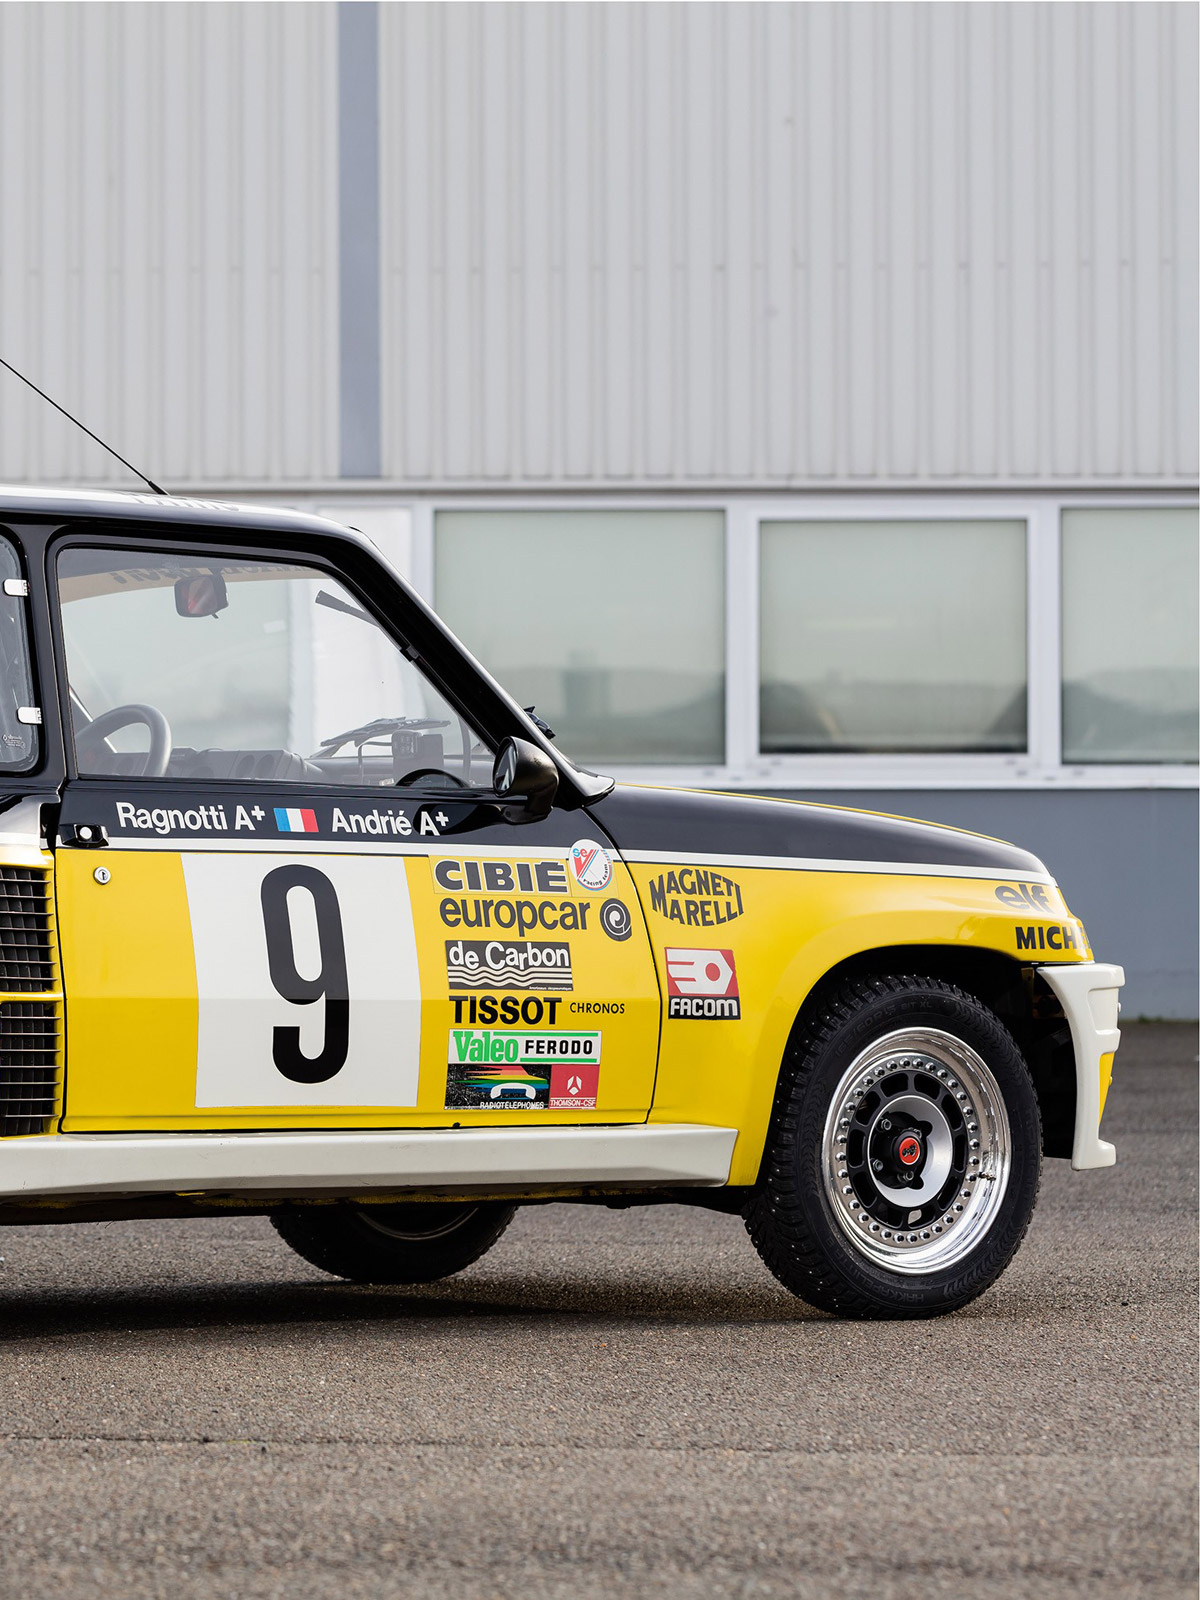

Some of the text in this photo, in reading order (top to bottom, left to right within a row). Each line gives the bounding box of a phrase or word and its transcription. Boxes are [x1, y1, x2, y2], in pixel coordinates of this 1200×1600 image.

[116, 802, 450, 836] Ragnotti A+ Andrié A+
[648, 868, 744, 904] MAGNETI
[995, 883, 1055, 914] elf
[439, 897, 591, 938] europcar
[449, 940, 570, 970] de Carbon
[260, 864, 350, 1084] 9
[448, 995, 625, 1025] TISSOT CHRONOS
[670, 997, 738, 1017] FACOM
[453, 1030, 519, 1063] Valeo
[524, 1039, 593, 1055] FERODO
[550, 1098, 596, 1108] THOMSON-CSF
